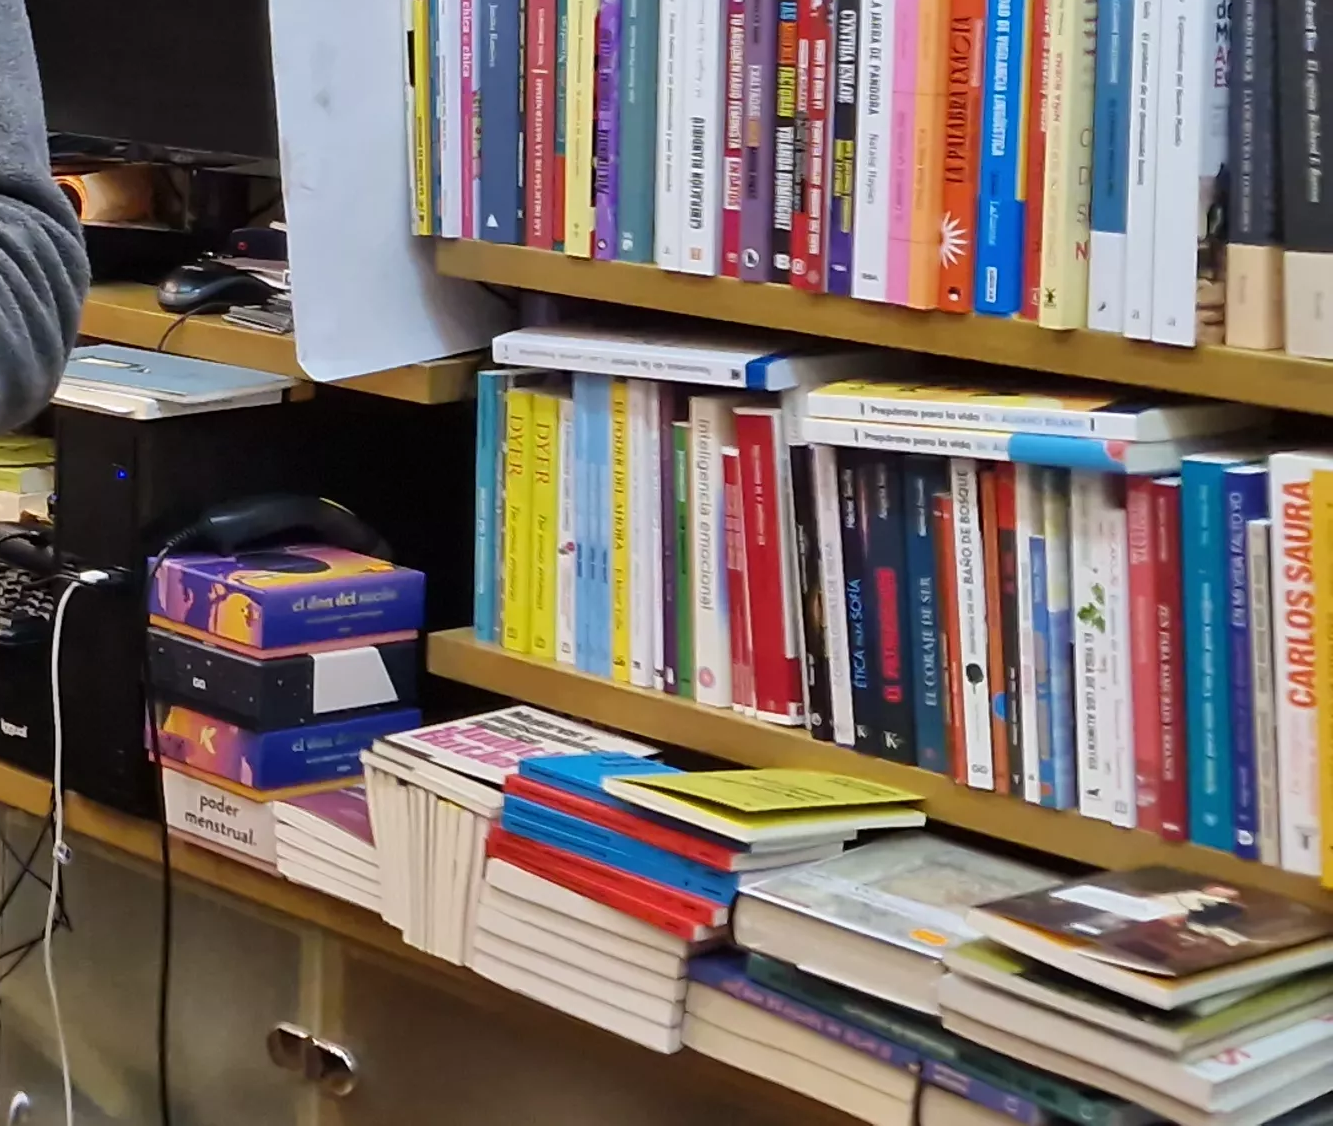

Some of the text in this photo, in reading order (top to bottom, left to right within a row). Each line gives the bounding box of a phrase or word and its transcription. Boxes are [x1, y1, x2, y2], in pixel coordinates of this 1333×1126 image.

[869, 46, 880, 61] DE
[508, 414, 525, 477] DYER
[534, 423, 551, 485] DYER
[697, 418, 714, 611] Inteligencia emocional
[961, 527, 972, 543] DE
[1281, 480, 1316, 710] CARLOS SAURA
[184, 812, 257, 847] menstrual.
[199, 794, 240, 819] poder
